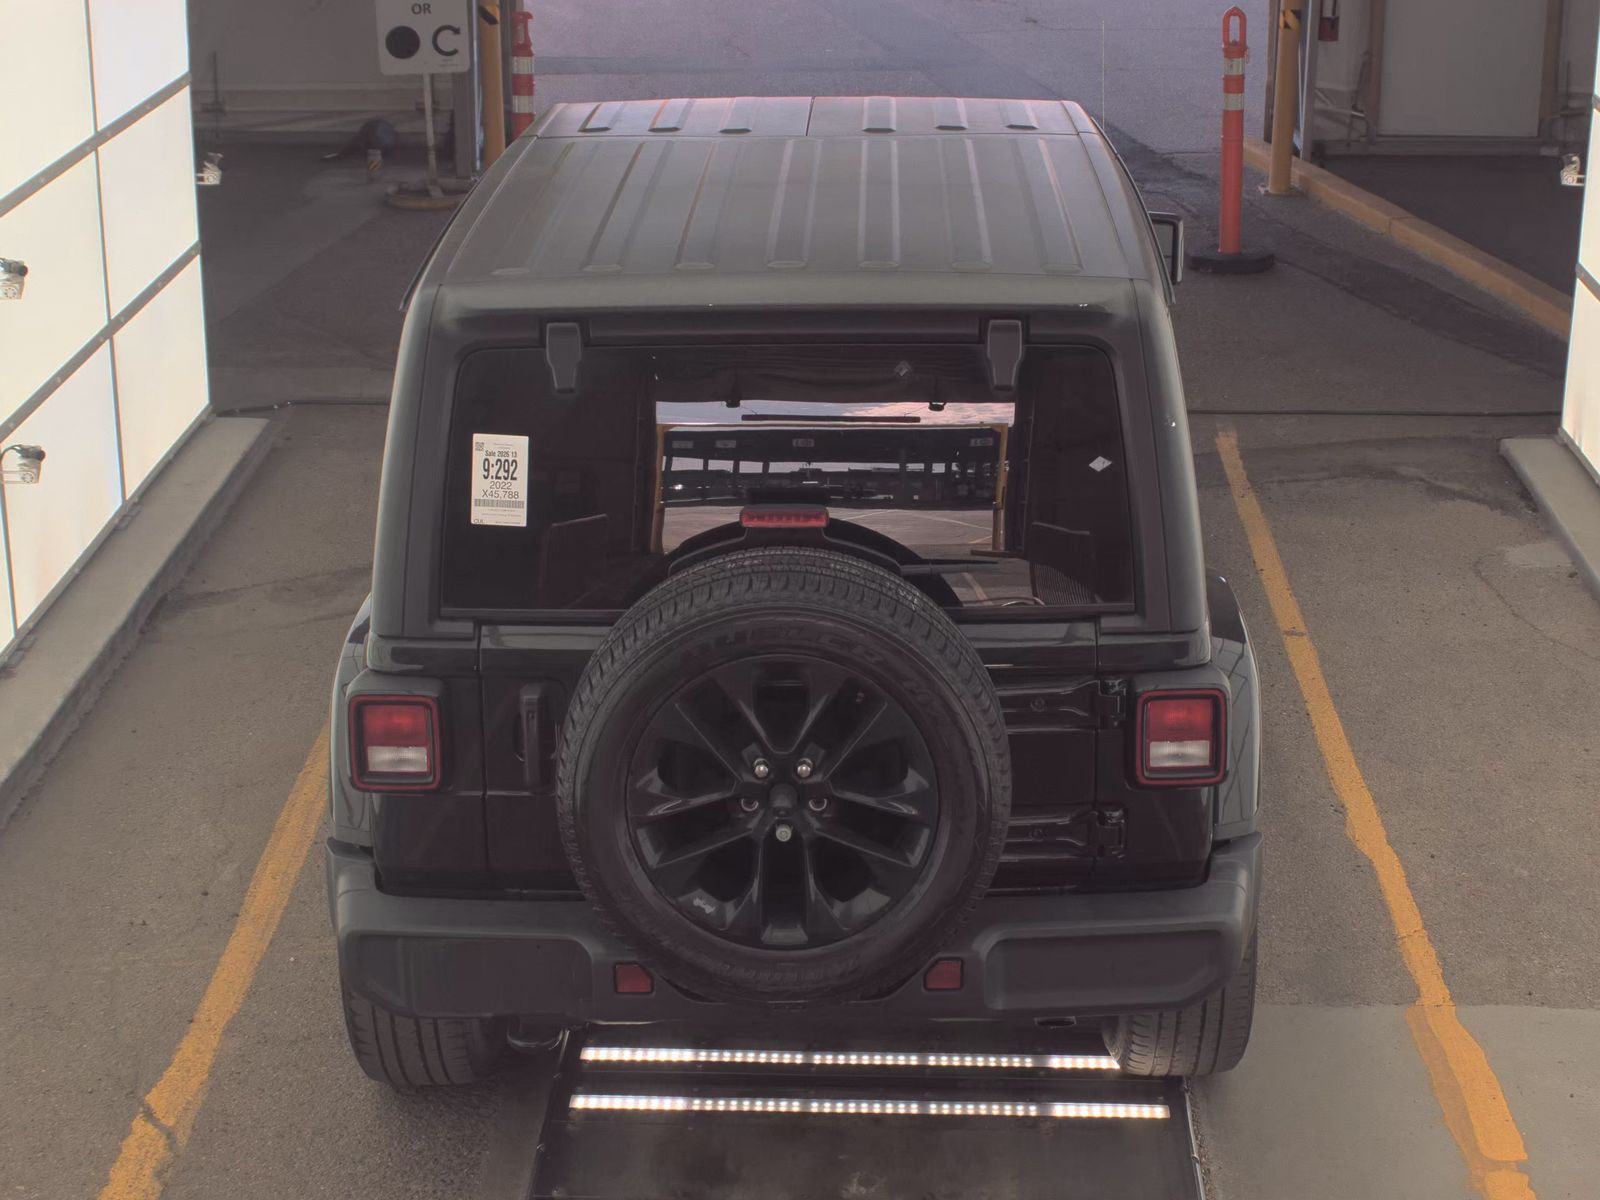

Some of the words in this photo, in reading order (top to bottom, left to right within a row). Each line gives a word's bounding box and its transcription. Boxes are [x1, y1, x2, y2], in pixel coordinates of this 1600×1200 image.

[411, 3, 432, 15] OR
[484, 449, 496, 457] Sale
[482, 458, 518, 481] 9:292
[489, 480, 513, 490] 2022
[481, 489, 520, 499] X45,788
